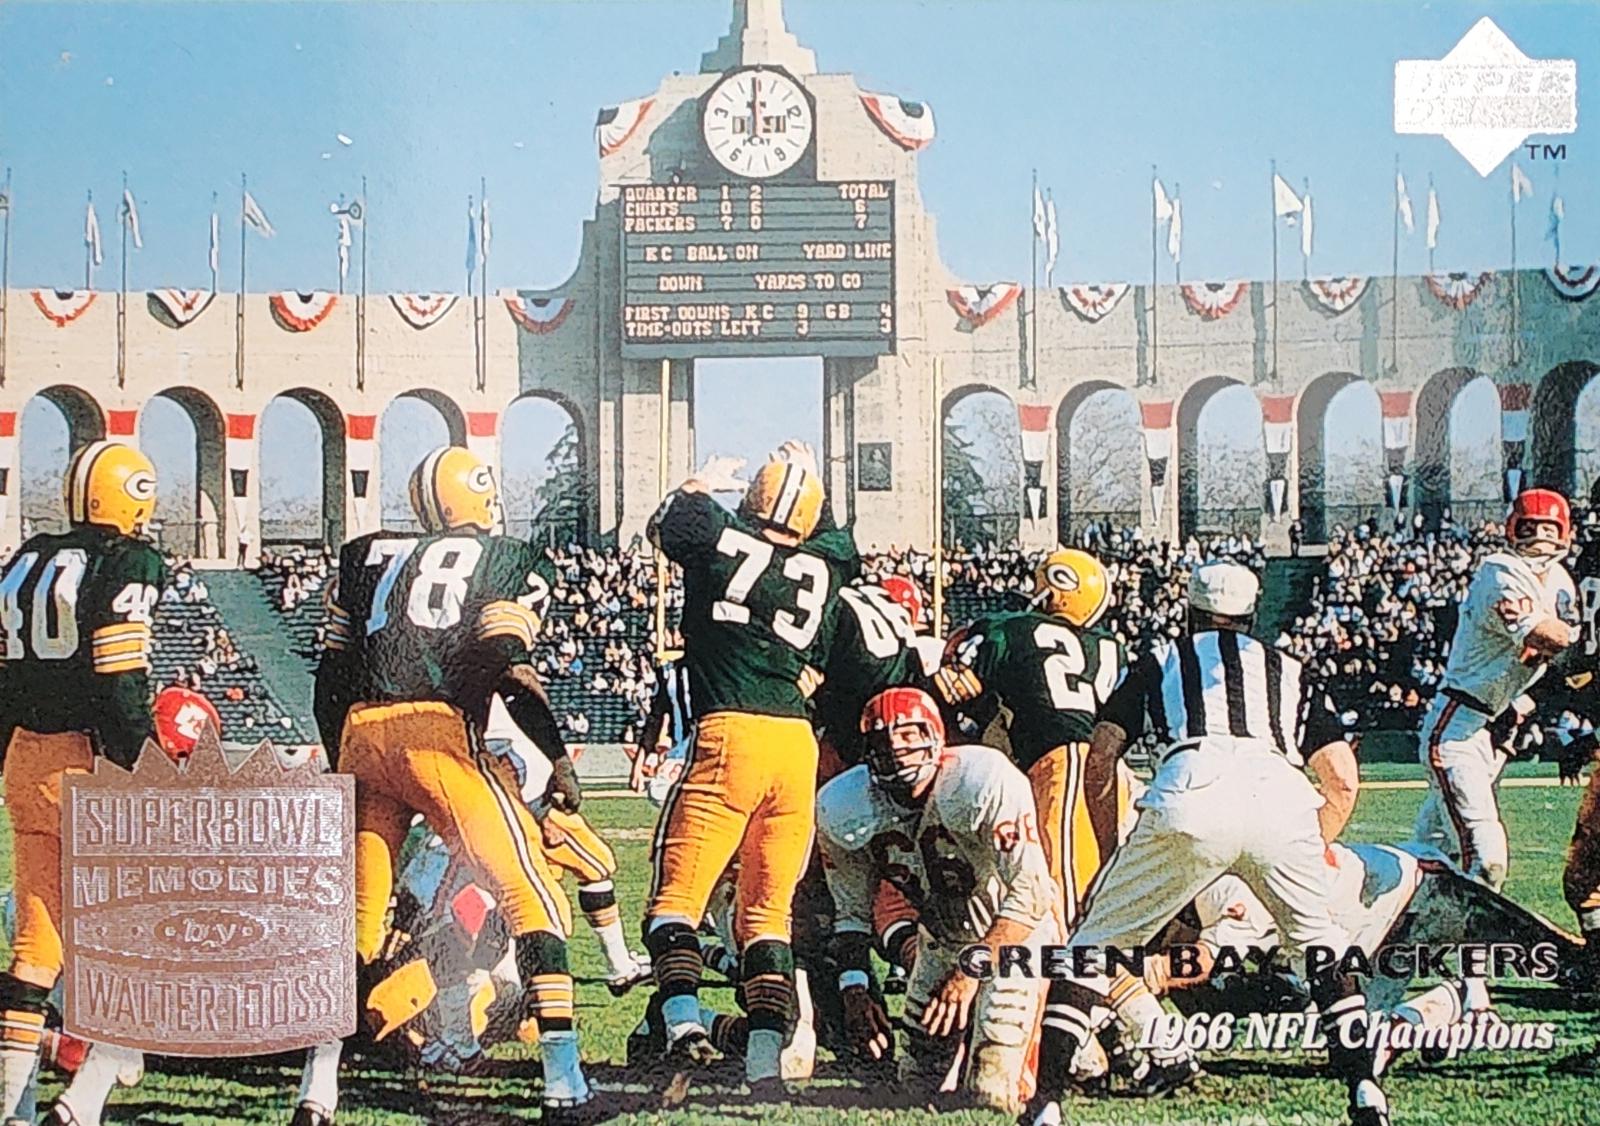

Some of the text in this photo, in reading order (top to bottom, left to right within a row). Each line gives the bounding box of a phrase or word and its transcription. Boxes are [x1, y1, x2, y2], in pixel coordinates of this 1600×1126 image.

[625, 184, 889, 201] QUARTER 1 2 TOTAL
[625, 202, 680, 216] CHIEFS
[750, 200, 763, 215] 6
[855, 200, 866, 213] 6
[624, 214, 867, 232] PACKERS 7 0 7
[686, 245, 728, 261] BALL
[735, 244, 760, 261] ON
[803, 243, 847, 260] YARD
[854, 243, 892, 259] LINE
[659, 275, 704, 291] DOWN
[814, 273, 835, 290] TO
[625, 306, 671, 321] FIRST
[677, 305, 731, 320] DOWNS
[797, 304, 809, 319] 9
[880, 303, 892, 318] 4
[721, 320, 762, 336] LEFT
[797, 320, 808, 335] 3
[880, 319, 892, 333] 3
[364, 537, 483, 636] 78
[712, 527, 830, 650] 73
